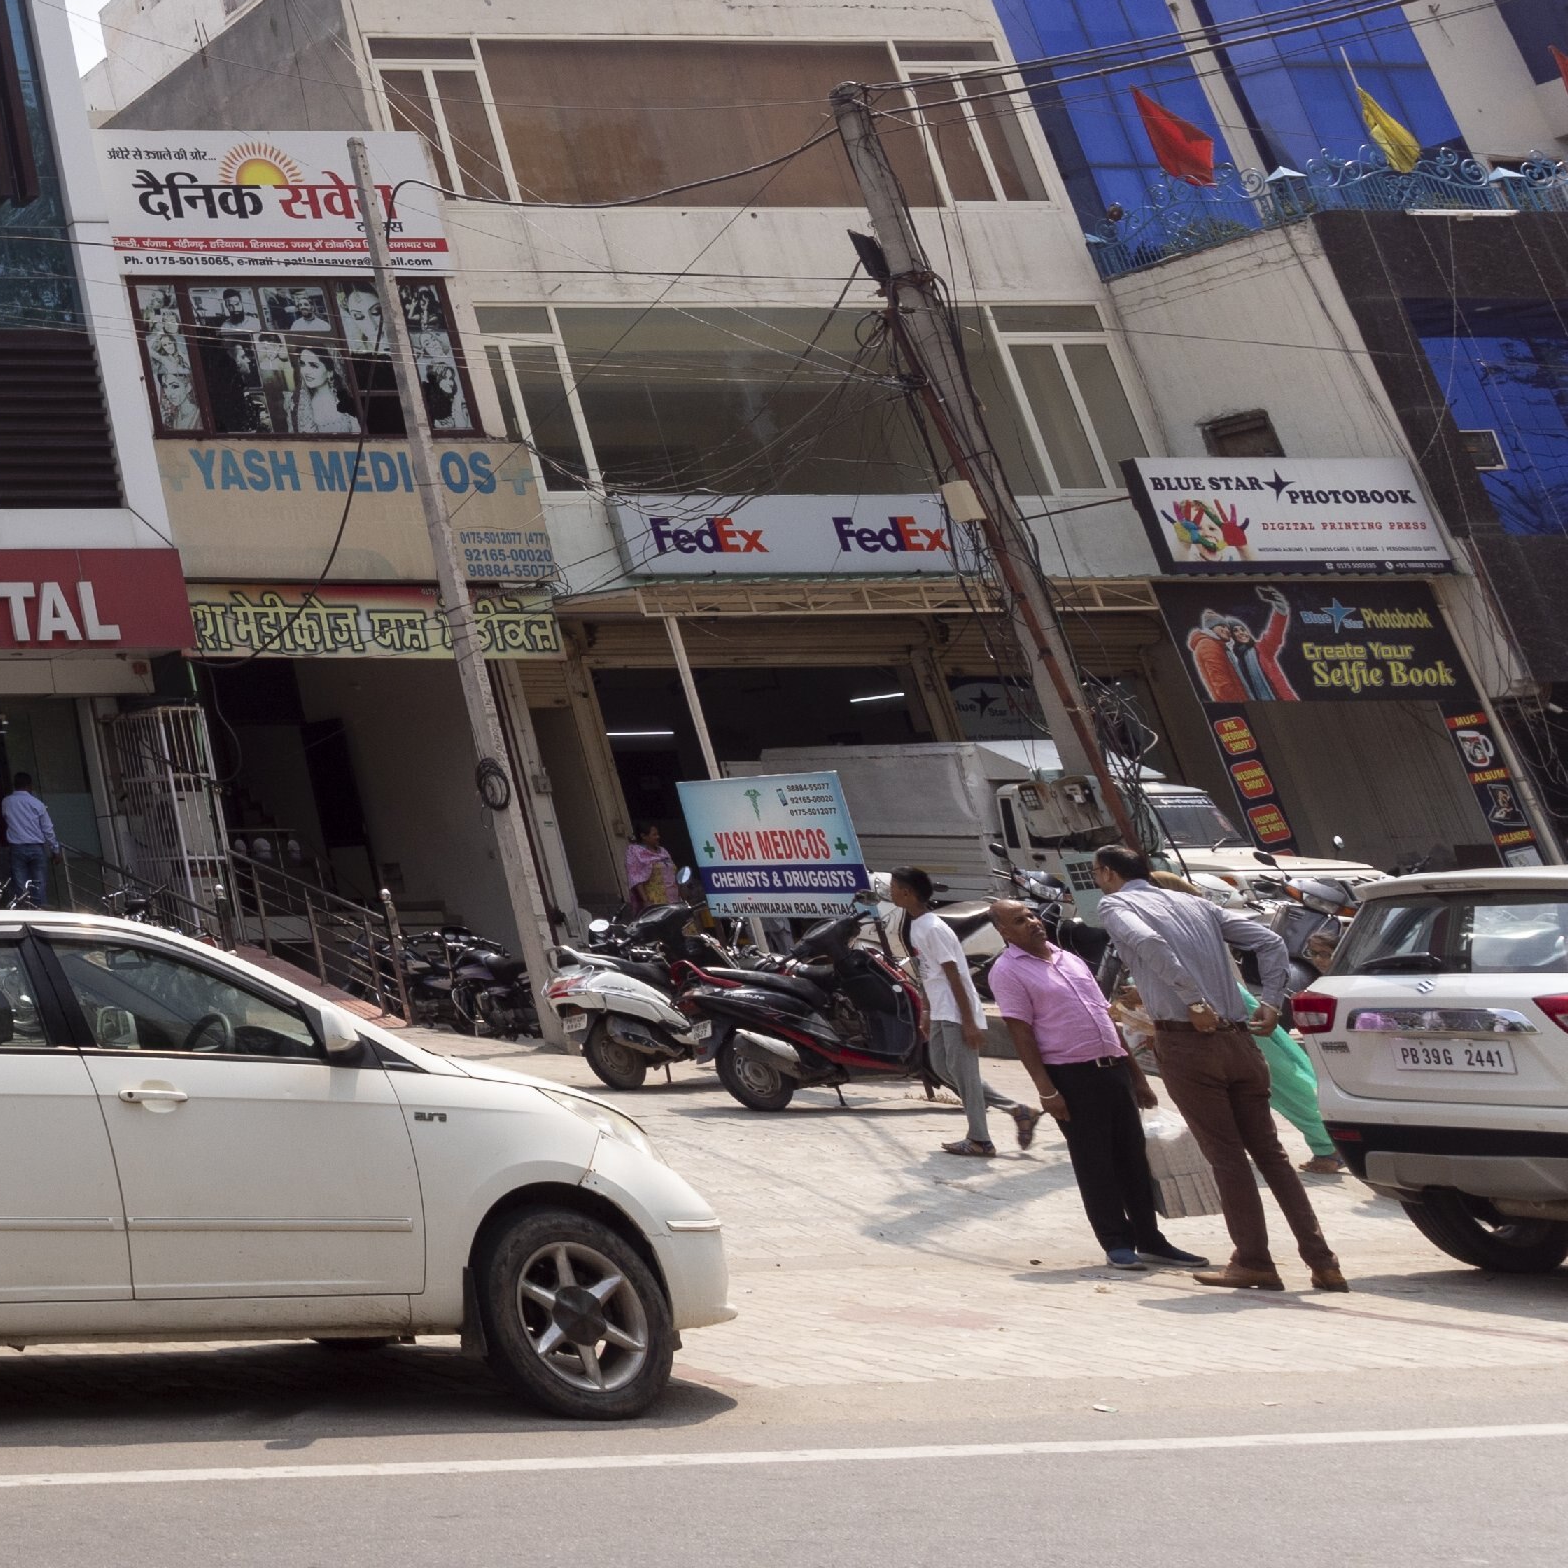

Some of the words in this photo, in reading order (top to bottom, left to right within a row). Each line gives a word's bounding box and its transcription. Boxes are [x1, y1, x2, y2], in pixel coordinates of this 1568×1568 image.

[132, 147, 143, 160] से
[173, 148, 189, 161] की
[132, 169, 263, 221] दैनिक
[273, 171, 398, 219] सवेा
[124, 256, 143, 265] Ph.
[190, 448, 301, 493] YASH
[309, 450, 497, 495] MEDIOS
[1149, 476, 1206, 491] BLUE
[1209, 475, 1265, 491] STAR
[1285, 489, 1417, 505] PHOTOBOOK
[832, 515, 952, 553] FedEx
[1262, 522, 1315, 531] DIGITAL
[1321, 521, 1383, 531] PRINTING
[1388, 521, 1428, 530] PRESS
[460, 532, 521, 545] 0175-5012077
[649, 516, 770, 555] FedEx
[465, 549, 552, 561] 92165-00020
[468, 564, 555, 577] 98884-55077
[1300, 611, 1333, 624] Blue
[1360, 607, 1434, 629] Photobook
[1302, 642, 1367, 660] Create
[1367, 641, 1414, 660] Your
[1312, 661, 1384, 693] Selfie
[1387, 660, 1456, 686] Book
[956, 699, 977, 712] lue
[1454, 714, 1478, 726] MUG
[1474, 768, 1506, 782] ALBUM
[715, 831, 755, 861] YASH
[755, 828, 831, 860] MEDICOS
[712, 871, 769, 888] CHEMISTS
[772, 871, 781, 887] &
[783, 870, 856, 888] DRUGGISTS
[1464, 1049, 1504, 1068] 2441
